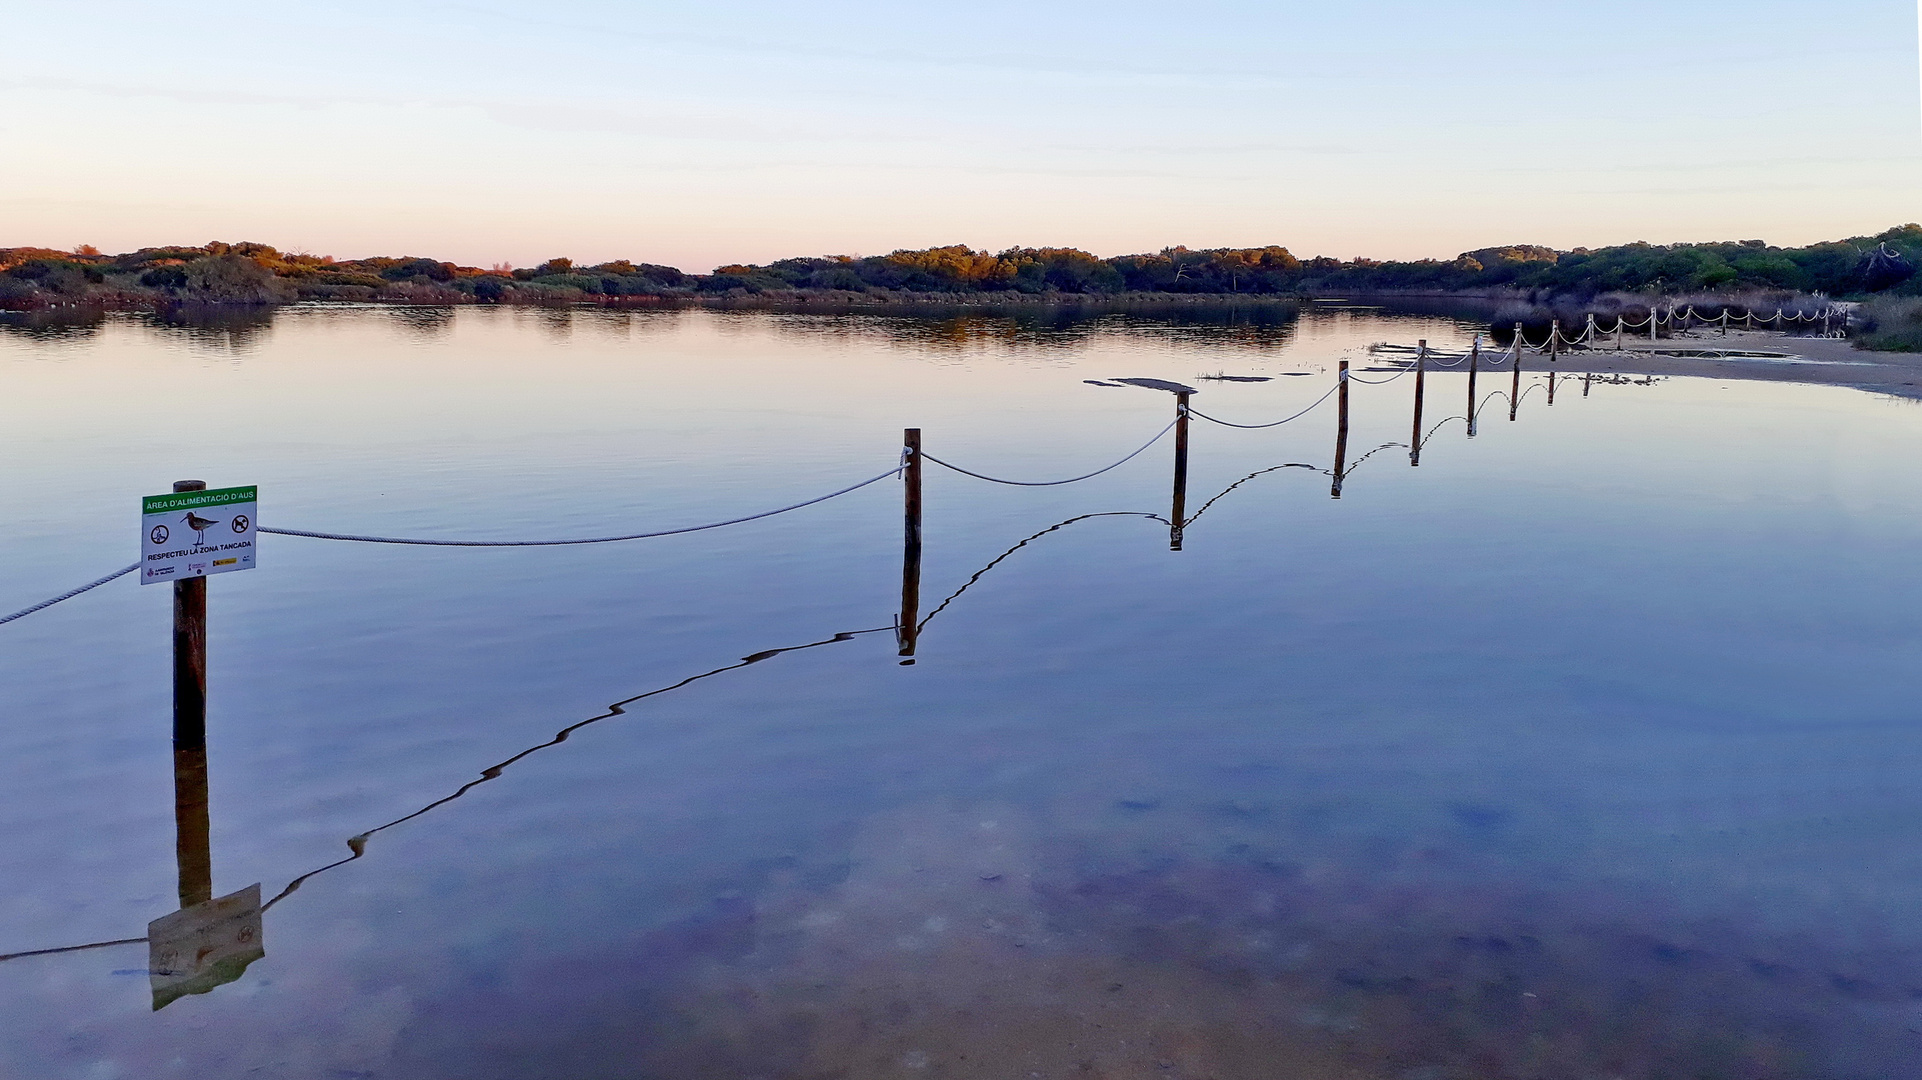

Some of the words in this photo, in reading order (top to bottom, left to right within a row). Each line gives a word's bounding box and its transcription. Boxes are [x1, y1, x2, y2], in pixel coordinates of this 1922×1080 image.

[169, 494, 229, 507] D'ALIMENTACIÓ
[231, 491, 254, 500] D'AUS
[148, 550, 189, 561] RESPECTEU
[200, 546, 219, 554] ZONA
[219, 541, 252, 551] TANCADA
